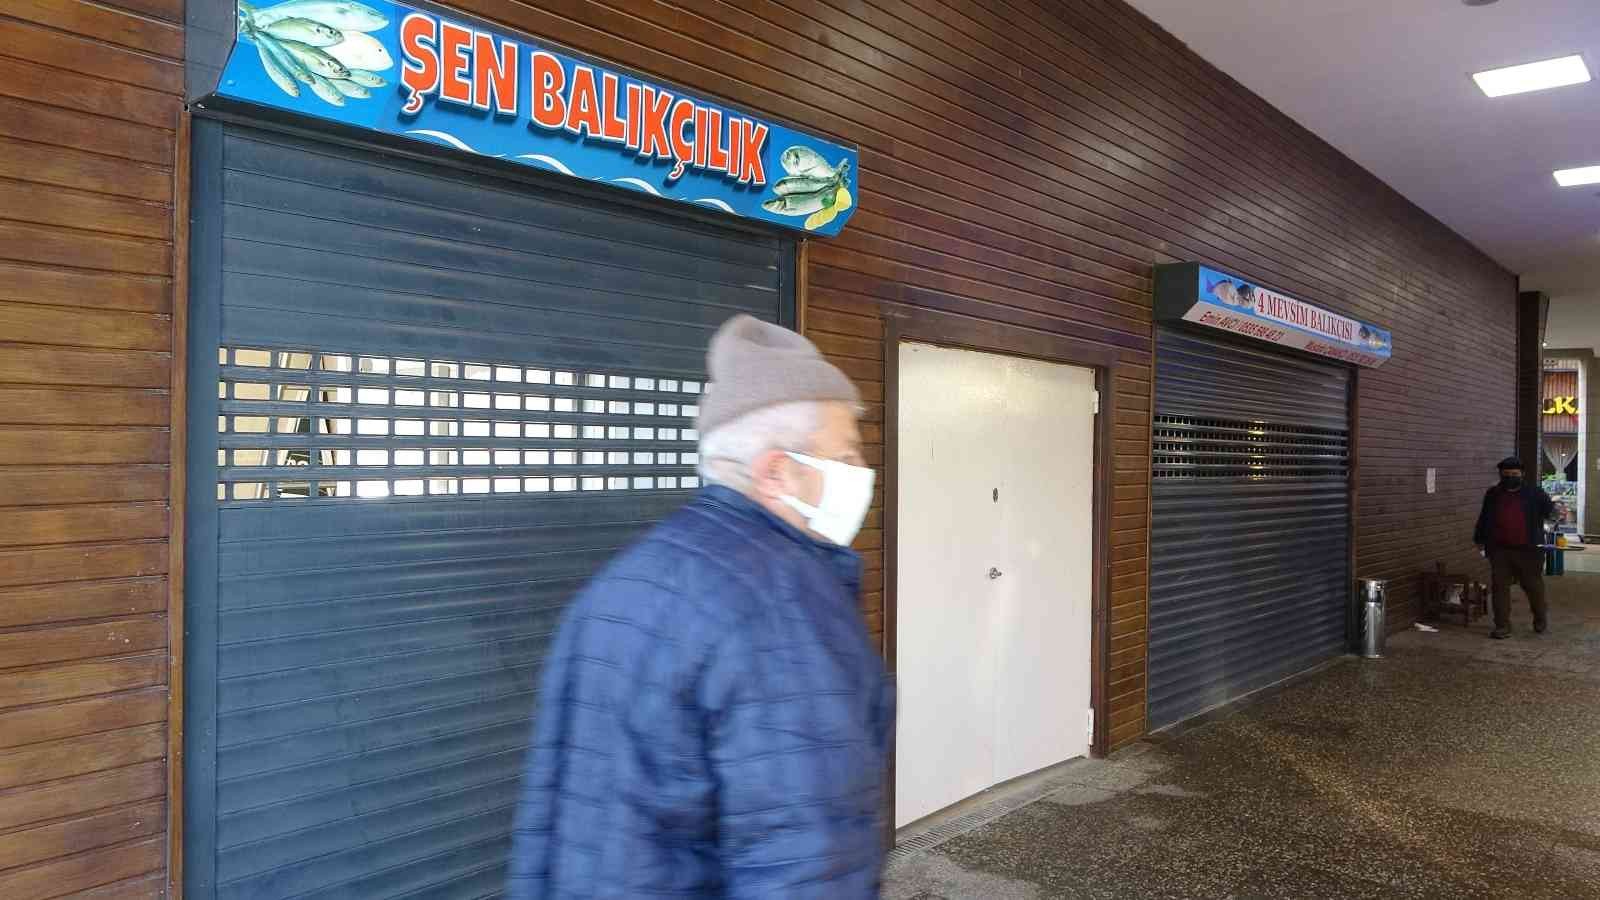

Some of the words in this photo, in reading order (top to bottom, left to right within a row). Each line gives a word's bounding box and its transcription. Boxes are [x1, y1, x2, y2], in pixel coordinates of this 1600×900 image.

[399, 14, 518, 114] ŞEN
[531, 51, 768, 185] BALIKÇILIK
[1257, 292, 1265, 313] 4
